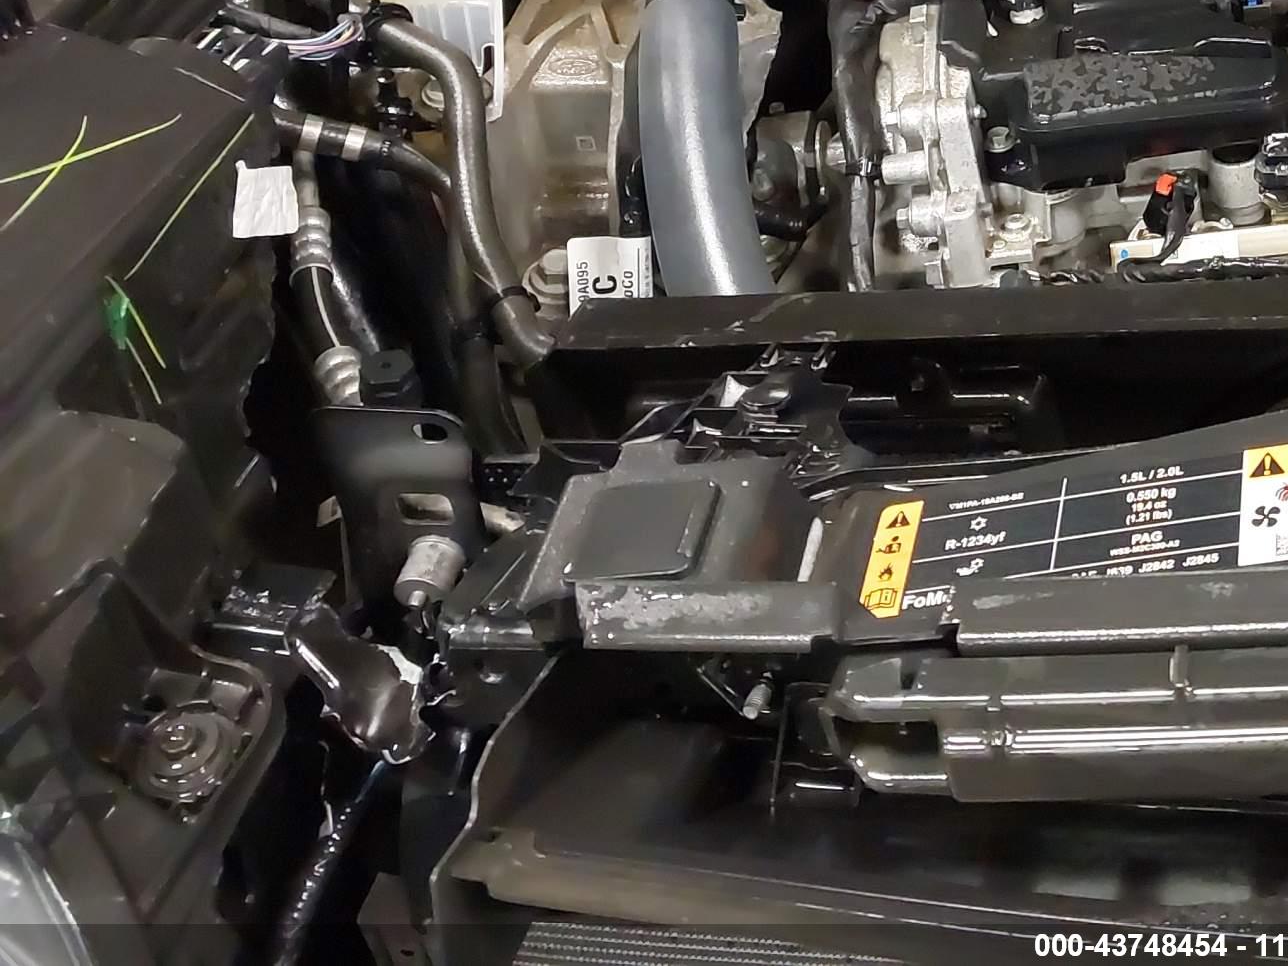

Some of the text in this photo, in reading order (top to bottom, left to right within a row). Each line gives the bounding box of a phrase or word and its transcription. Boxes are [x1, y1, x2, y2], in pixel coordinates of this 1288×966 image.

[592, 275, 617, 295] C
[1120, 472, 1146, 484] 1.5L
[1156, 466, 1184, 479] 2.0L
[1126, 487, 1176, 503] 0.550 kg
[1154, 500, 1167, 509] oz
[1126, 509, 1173, 525] (1.21 lbs)
[945, 531, 1006, 551] R-1234yf
[1131, 531, 1163, 545] PAG
[1138, 559, 1175, 574] J2842
[1182, 553, 1219, 567] J2845
